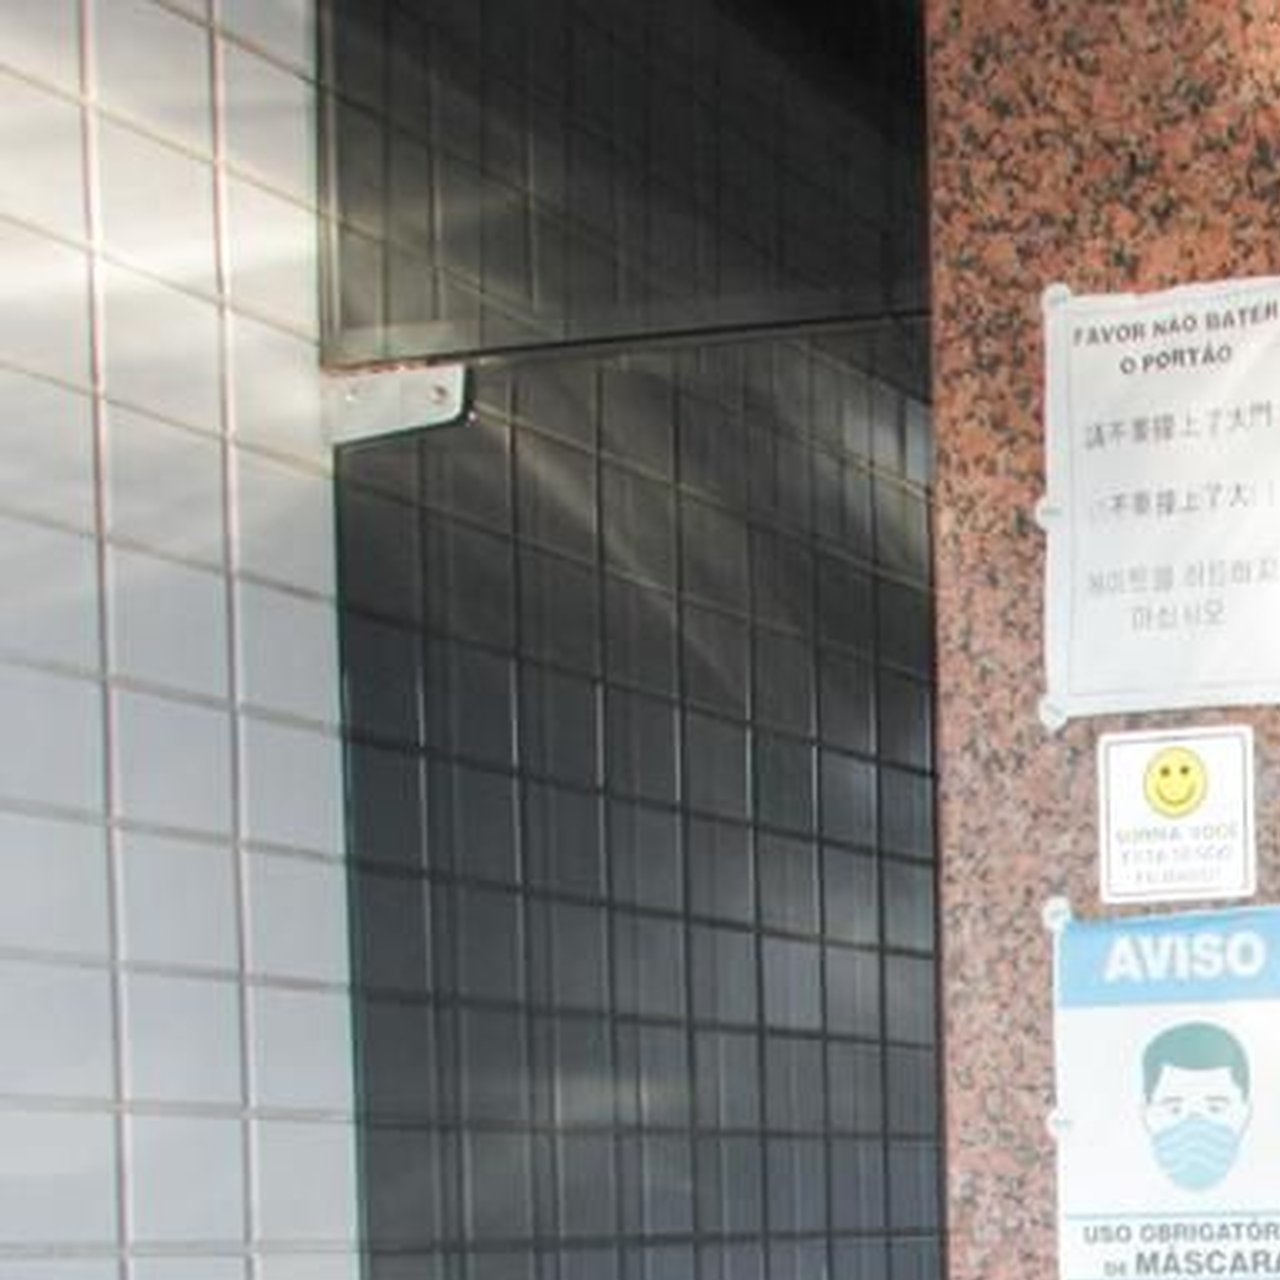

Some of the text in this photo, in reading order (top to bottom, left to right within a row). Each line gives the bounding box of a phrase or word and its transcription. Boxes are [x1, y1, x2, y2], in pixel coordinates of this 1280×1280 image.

[1073, 323, 1145, 347] FAVOR
[1205, 299, 1278, 331] BATER
[1119, 356, 1136, 375] O
[1104, 931, 1267, 985] AVISO
[1083, 1225, 1132, 1244] USO
